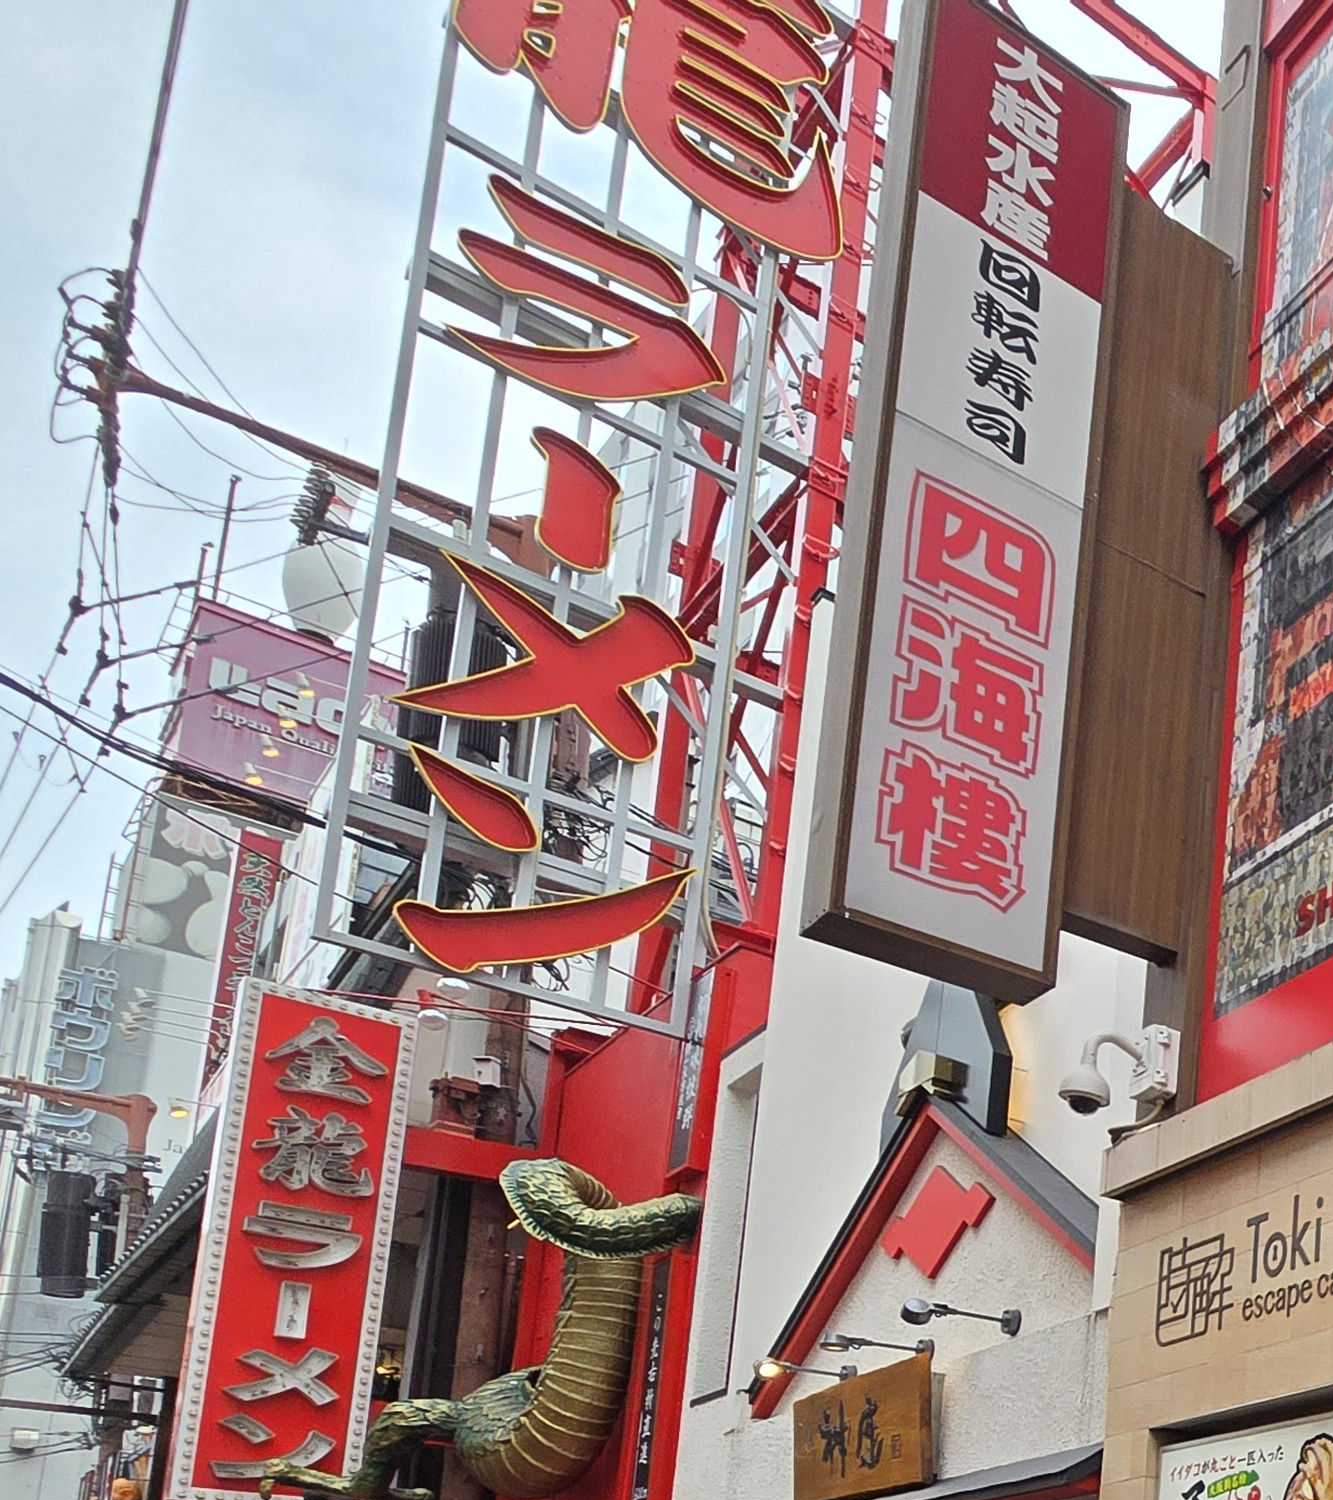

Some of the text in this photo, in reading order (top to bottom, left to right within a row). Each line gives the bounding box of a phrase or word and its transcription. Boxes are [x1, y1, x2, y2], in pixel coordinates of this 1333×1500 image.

[964, 34, 1066, 466] 大起水産 回転寿司
[211, 704, 272, 735] Japan
[209, 1015, 389, 1480] 金龍ラーメン
[1247, 1194, 1324, 1284] Toki
[1242, 1279, 1313, 1321] escape
